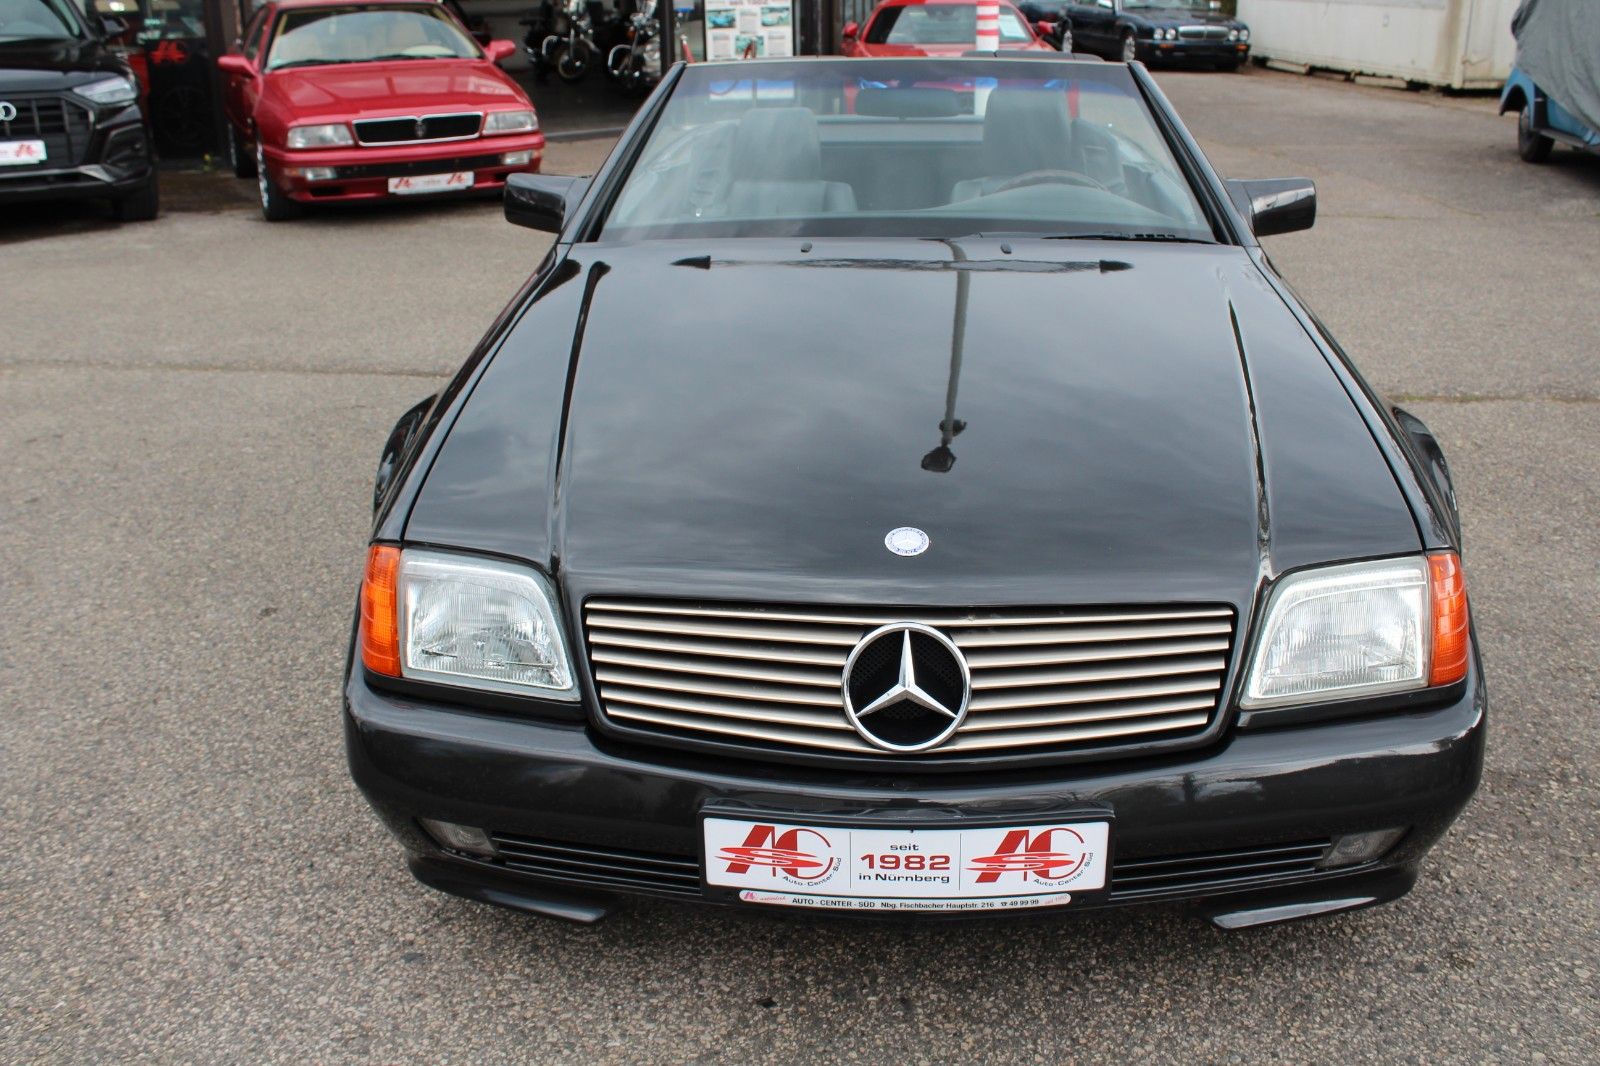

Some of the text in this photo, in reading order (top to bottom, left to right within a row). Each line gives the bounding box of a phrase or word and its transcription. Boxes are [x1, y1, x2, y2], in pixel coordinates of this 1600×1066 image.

[890, 843, 919, 851] seit
[860, 853, 951, 871] 1982
[859, 872, 950, 884] in Nürnberg
[792, 897, 814, 905] AUTO
[820, 899, 852, 907] CENTER
[858, 900, 875, 908] SÜD
[881, 902, 898, 910] Nbg.
[945, 901, 979, 910] Hauptstr.
